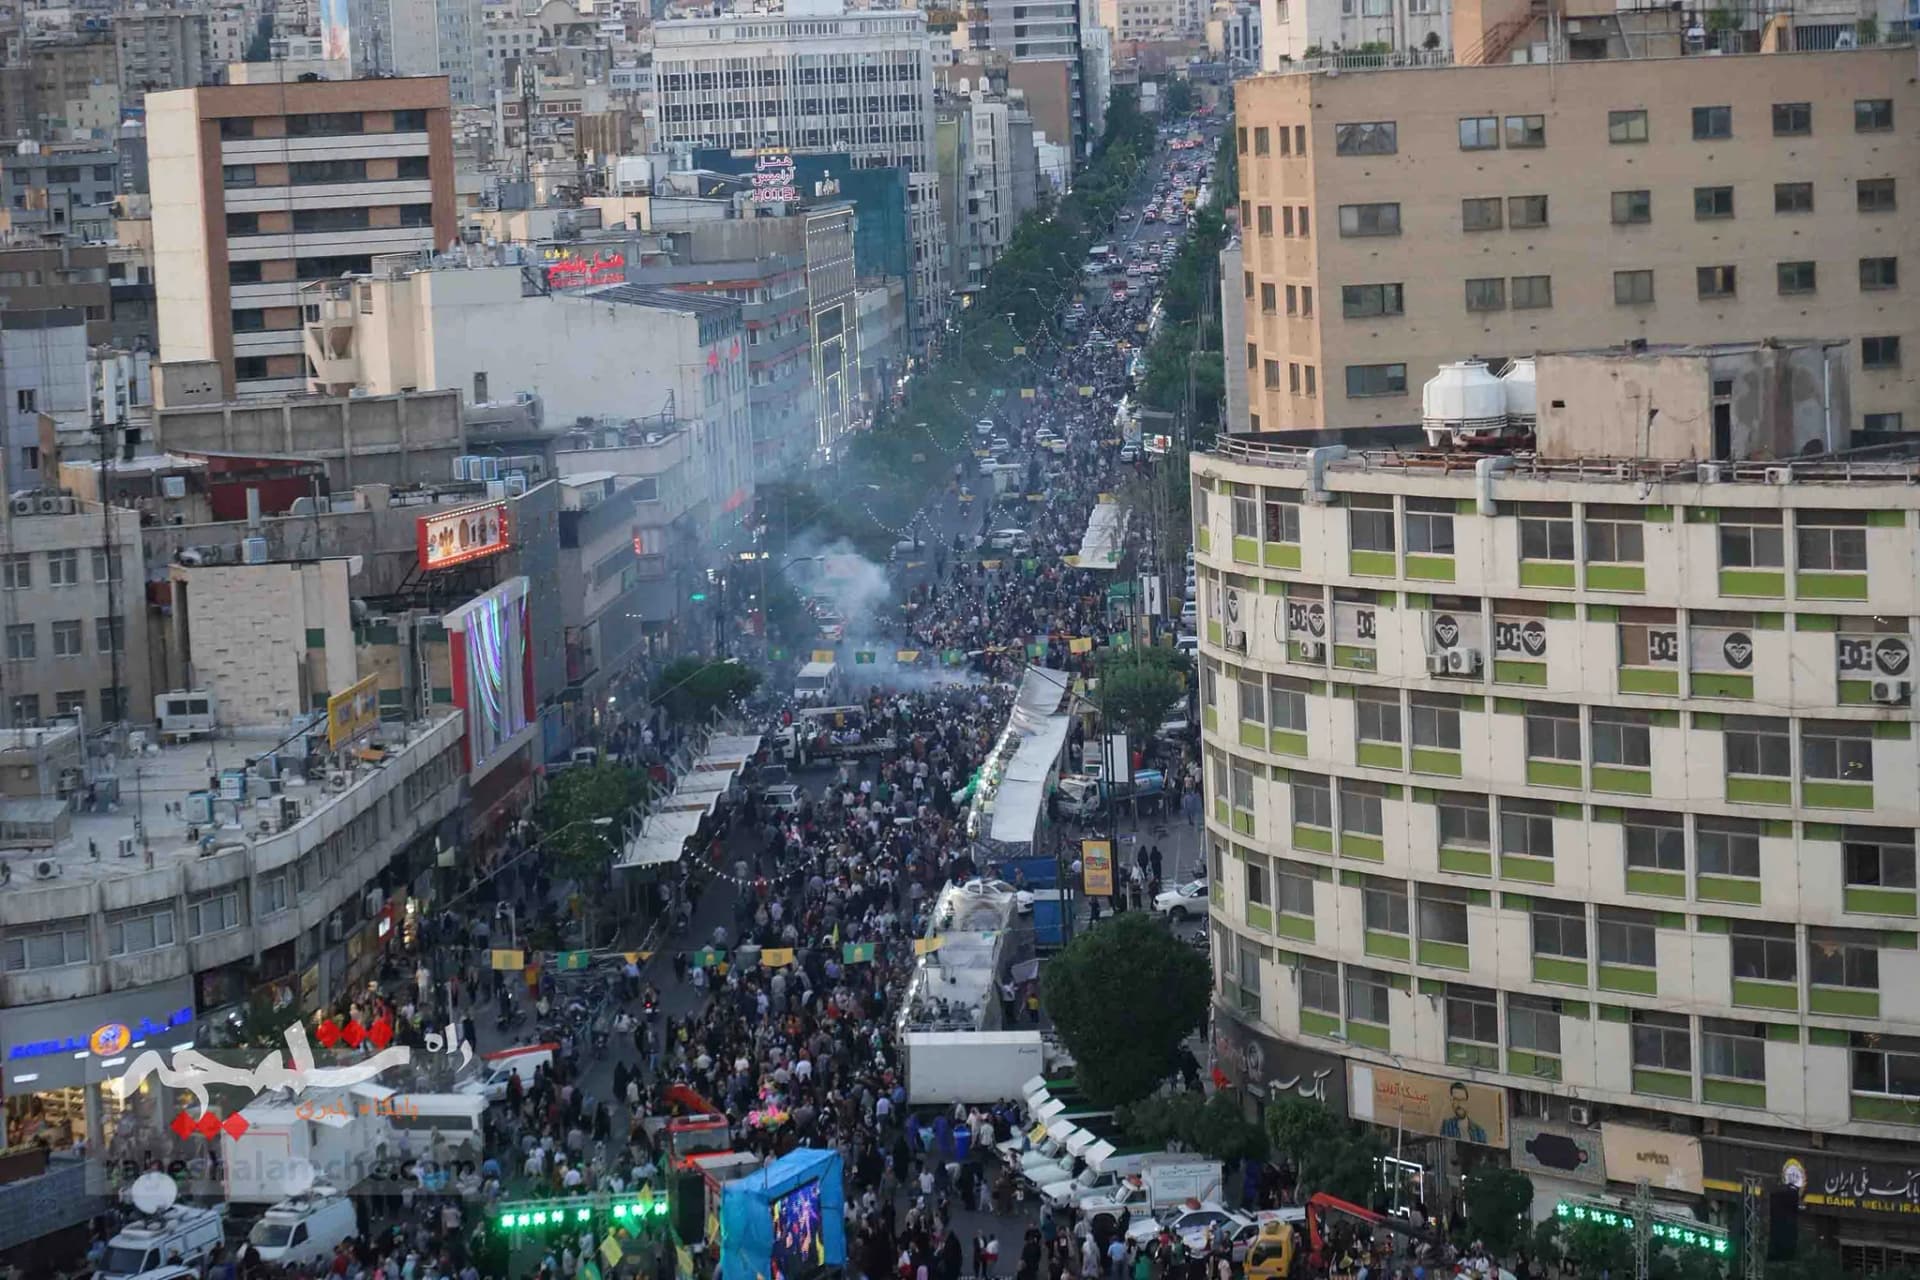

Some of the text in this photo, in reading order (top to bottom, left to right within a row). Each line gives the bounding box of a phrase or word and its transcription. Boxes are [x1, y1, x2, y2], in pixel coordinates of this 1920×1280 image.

[755, 155, 793, 171] هتل
[752, 187, 800, 202] HOTEL
[1824, 1170, 1854, 1197] ایران
[1826, 1196, 1856, 1208] BANK
[1862, 1200, 1894, 1212] MELLI
